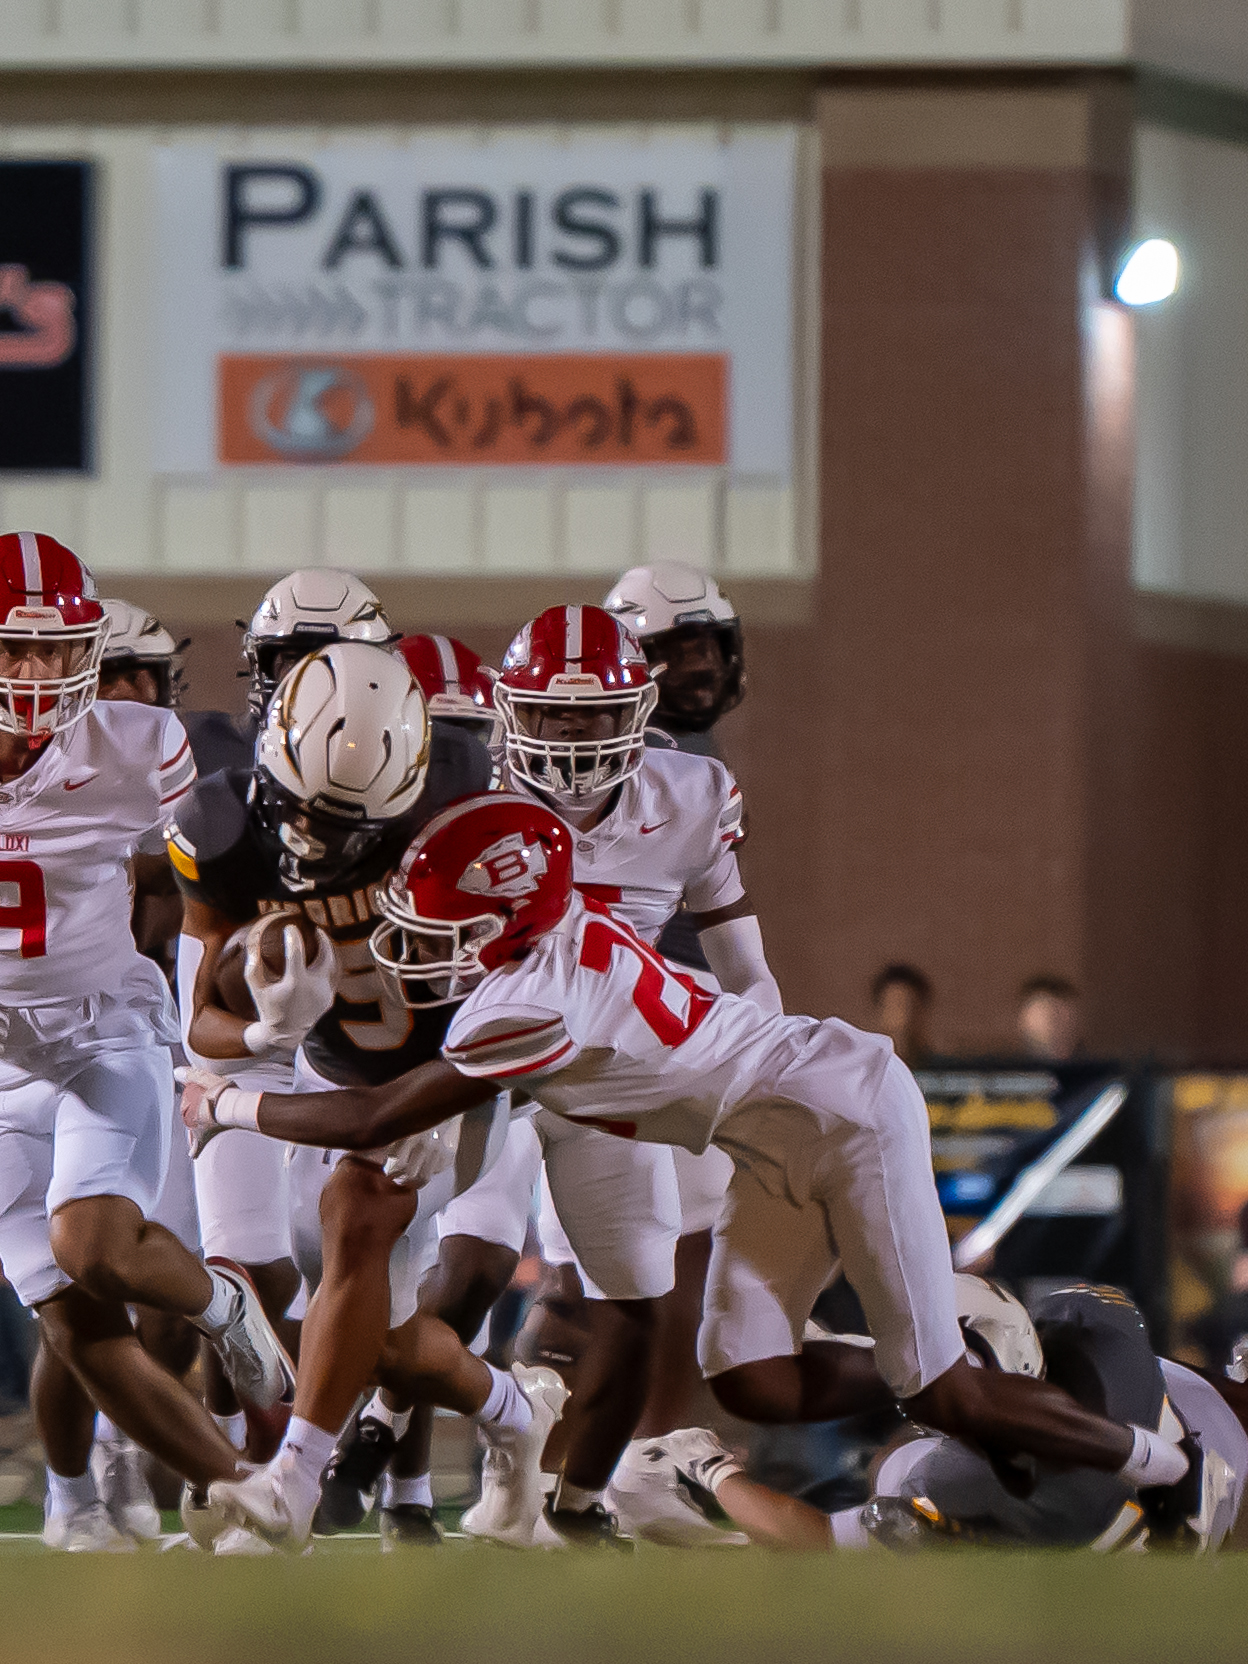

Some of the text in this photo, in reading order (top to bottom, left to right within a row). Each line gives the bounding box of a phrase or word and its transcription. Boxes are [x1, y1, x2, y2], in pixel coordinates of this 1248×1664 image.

[220, 157, 722, 270] PARISH
[370, 277, 724, 337] TRACTOR
[393, 372, 700, 451] Kubota
[481, 848, 529, 889] B
